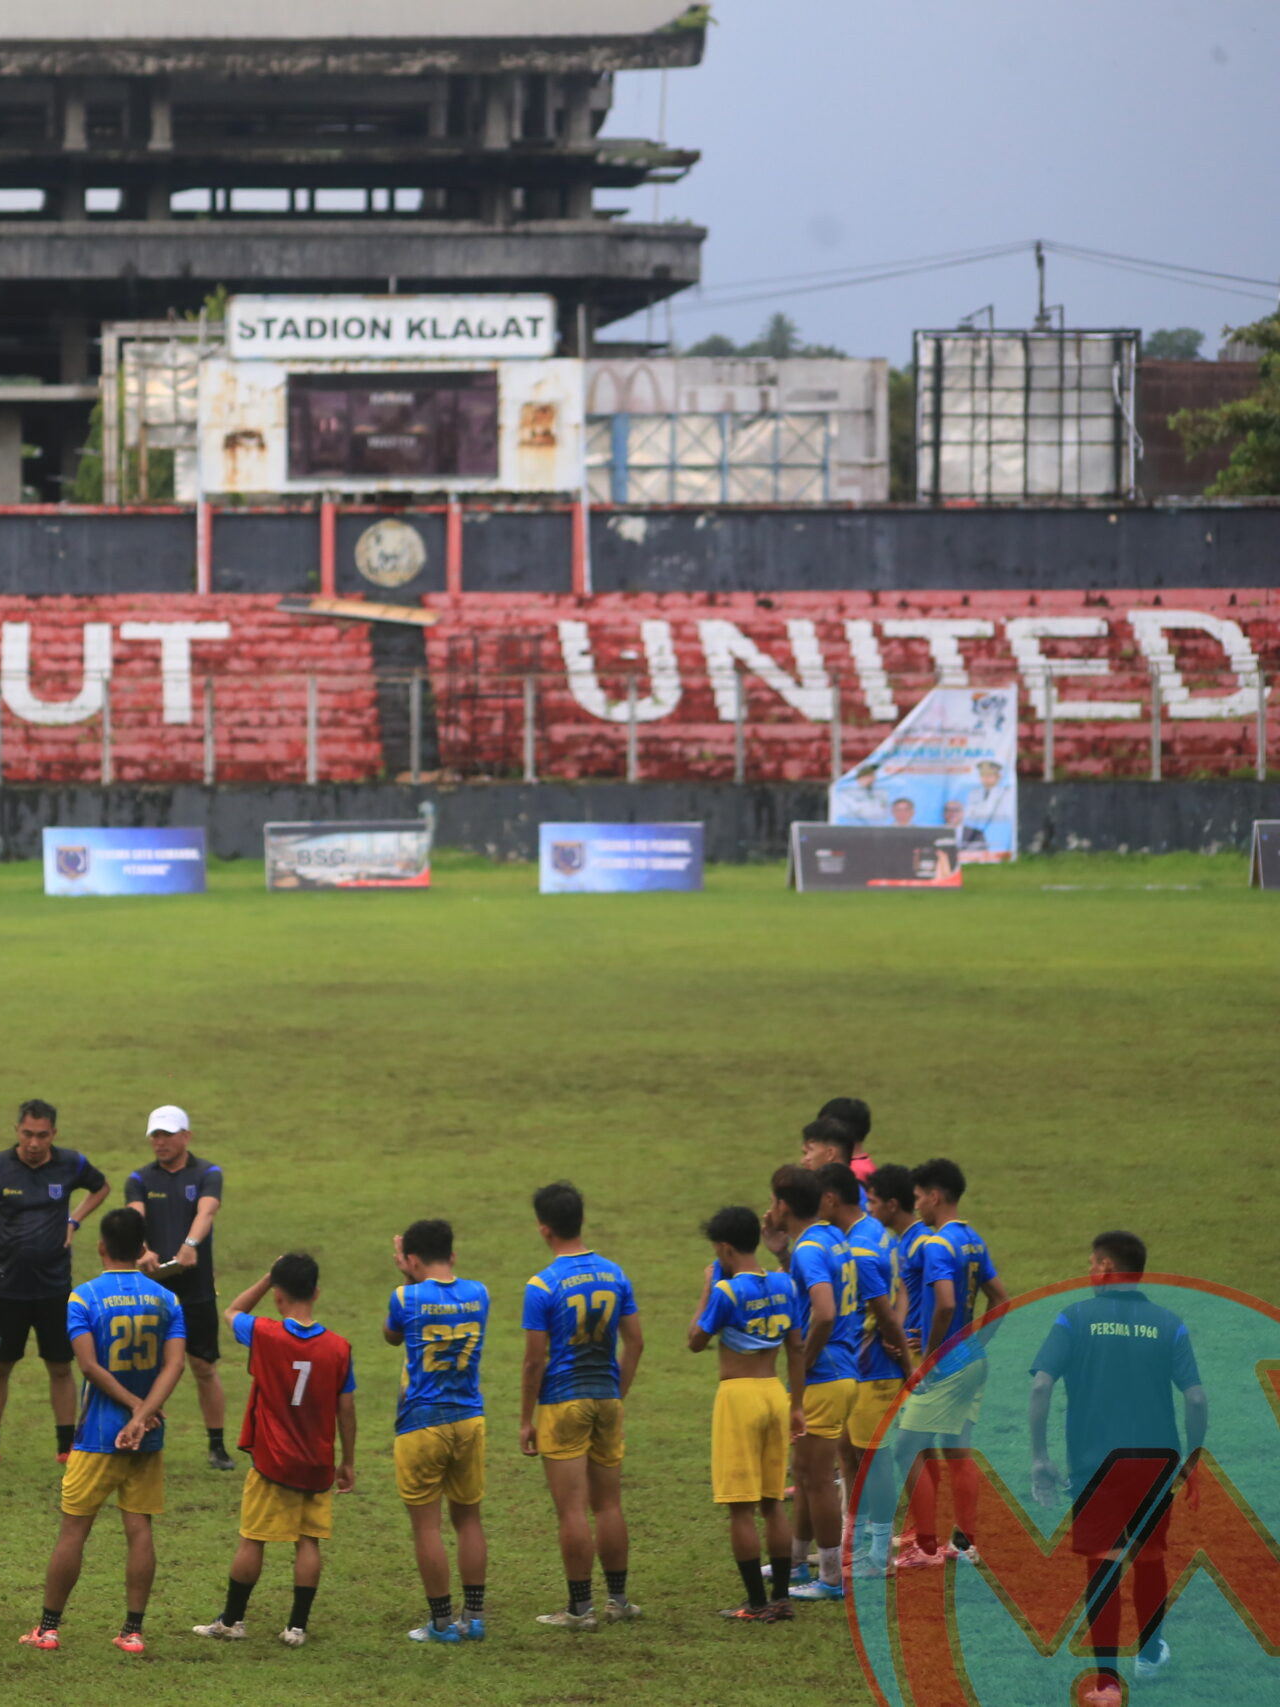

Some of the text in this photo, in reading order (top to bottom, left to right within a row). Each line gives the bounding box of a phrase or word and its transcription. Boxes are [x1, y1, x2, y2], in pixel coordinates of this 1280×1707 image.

[238, 316, 392, 340] STADION
[558, 610, 1271, 722] UNITED
[102, 1294, 137, 1309] PERSMA
[567, 1290, 617, 1345] 17
[108, 1315, 159, 1372] 25
[422, 1321, 481, 1373] 27
[1090, 1322, 1158, 1339] PERSMA 1960
[292, 1361, 312, 1406] 7
